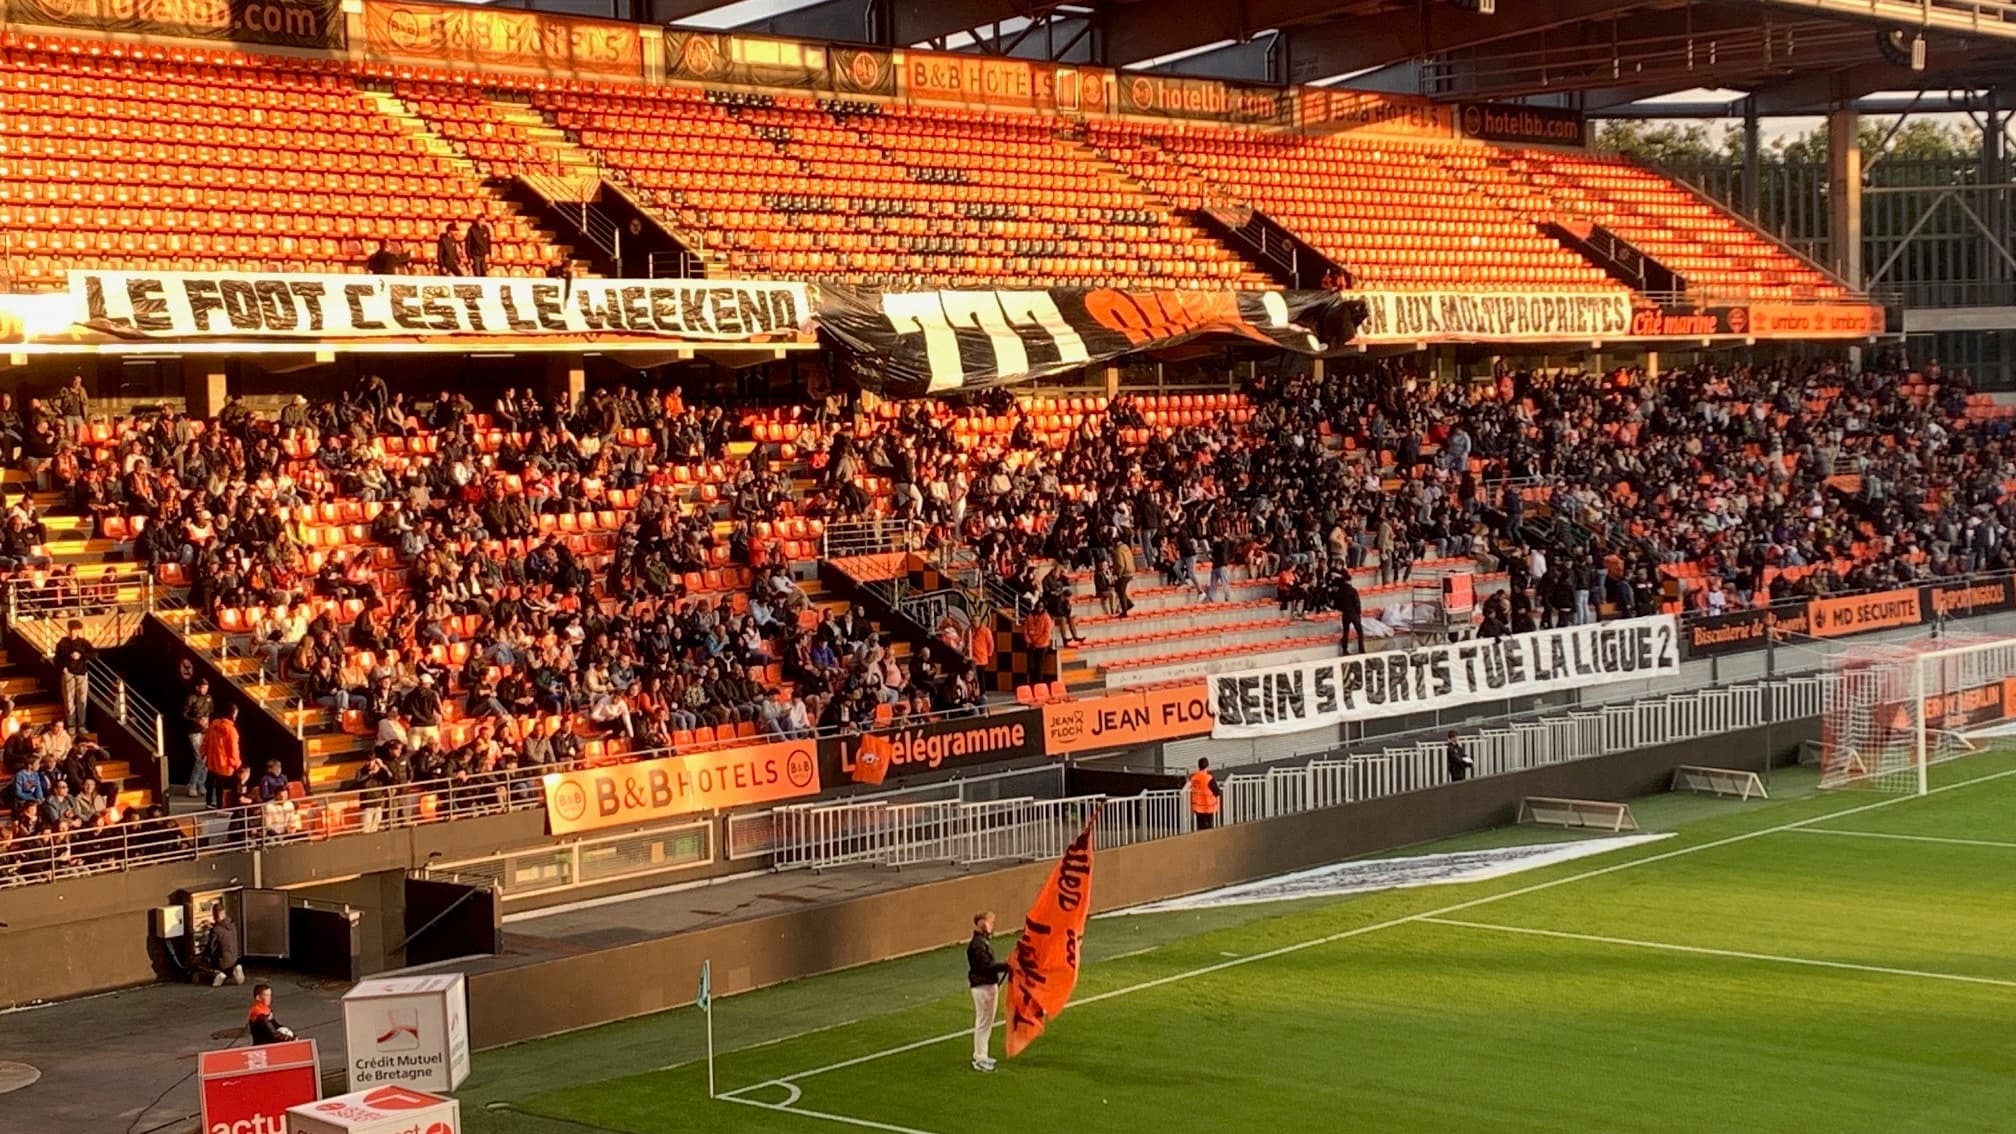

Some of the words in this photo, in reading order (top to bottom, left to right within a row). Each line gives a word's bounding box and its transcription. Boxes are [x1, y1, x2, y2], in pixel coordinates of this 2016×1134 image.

[430, 19, 499, 50] B&B
[505, 23, 619, 61] HOTELS
[914, 62, 961, 89] B&B
[970, 67, 1054, 97] HOTELS
[1158, 80, 1277, 117] hotelbb.com
[1375, 101, 1439, 127] HOTELS
[1484, 109, 1579, 138] hotelbb.com
[85, 275, 174, 331] LE
[182, 279, 326, 331] FOOT
[344, 279, 488, 331] C'EST
[499, 284, 568, 331] LE
[577, 286, 801, 333] WEEKEND
[1361, 294, 1388, 335] ON
[1395, 294, 1440, 335] AUX
[1441, 294, 1625, 334] MULTIPROPRIETES
[1633, 310, 1662, 335] Cité
[1664, 309, 1717, 334] marine
[1771, 314, 1809, 330] umbro
[1831, 314, 1865, 330] umbro
[1832, 608, 1853, 627] MD
[1217, 669, 1306, 725] BEIN
[1314, 650, 1452, 714] SPORTS
[1459, 639, 1526, 693] TUE
[1530, 634, 1569, 680] LA
[1572, 626, 1652, 675] LIGUE
[1657, 624, 1673, 667] 2
[1051, 716, 1074, 727] JEAN
[1051, 722, 1083, 738] FLOCH
[1091, 706, 1150, 736] JEAN
[1162, 698, 1215, 725] FLOC
[841, 741, 862, 772] L
[884, 723, 1024, 767] élégramme
[790, 761, 810, 774] B&B
[595, 768, 673, 818] B&B
[678, 759, 778, 797] HOTELS
[355, 1055, 394, 1070] Crédit
[397, 1052, 442, 1066] Mutuel
[356, 1070, 373, 1082] de
[375, 1067, 433, 1081] Bretagne
[211, 1112, 287, 1134] actu
